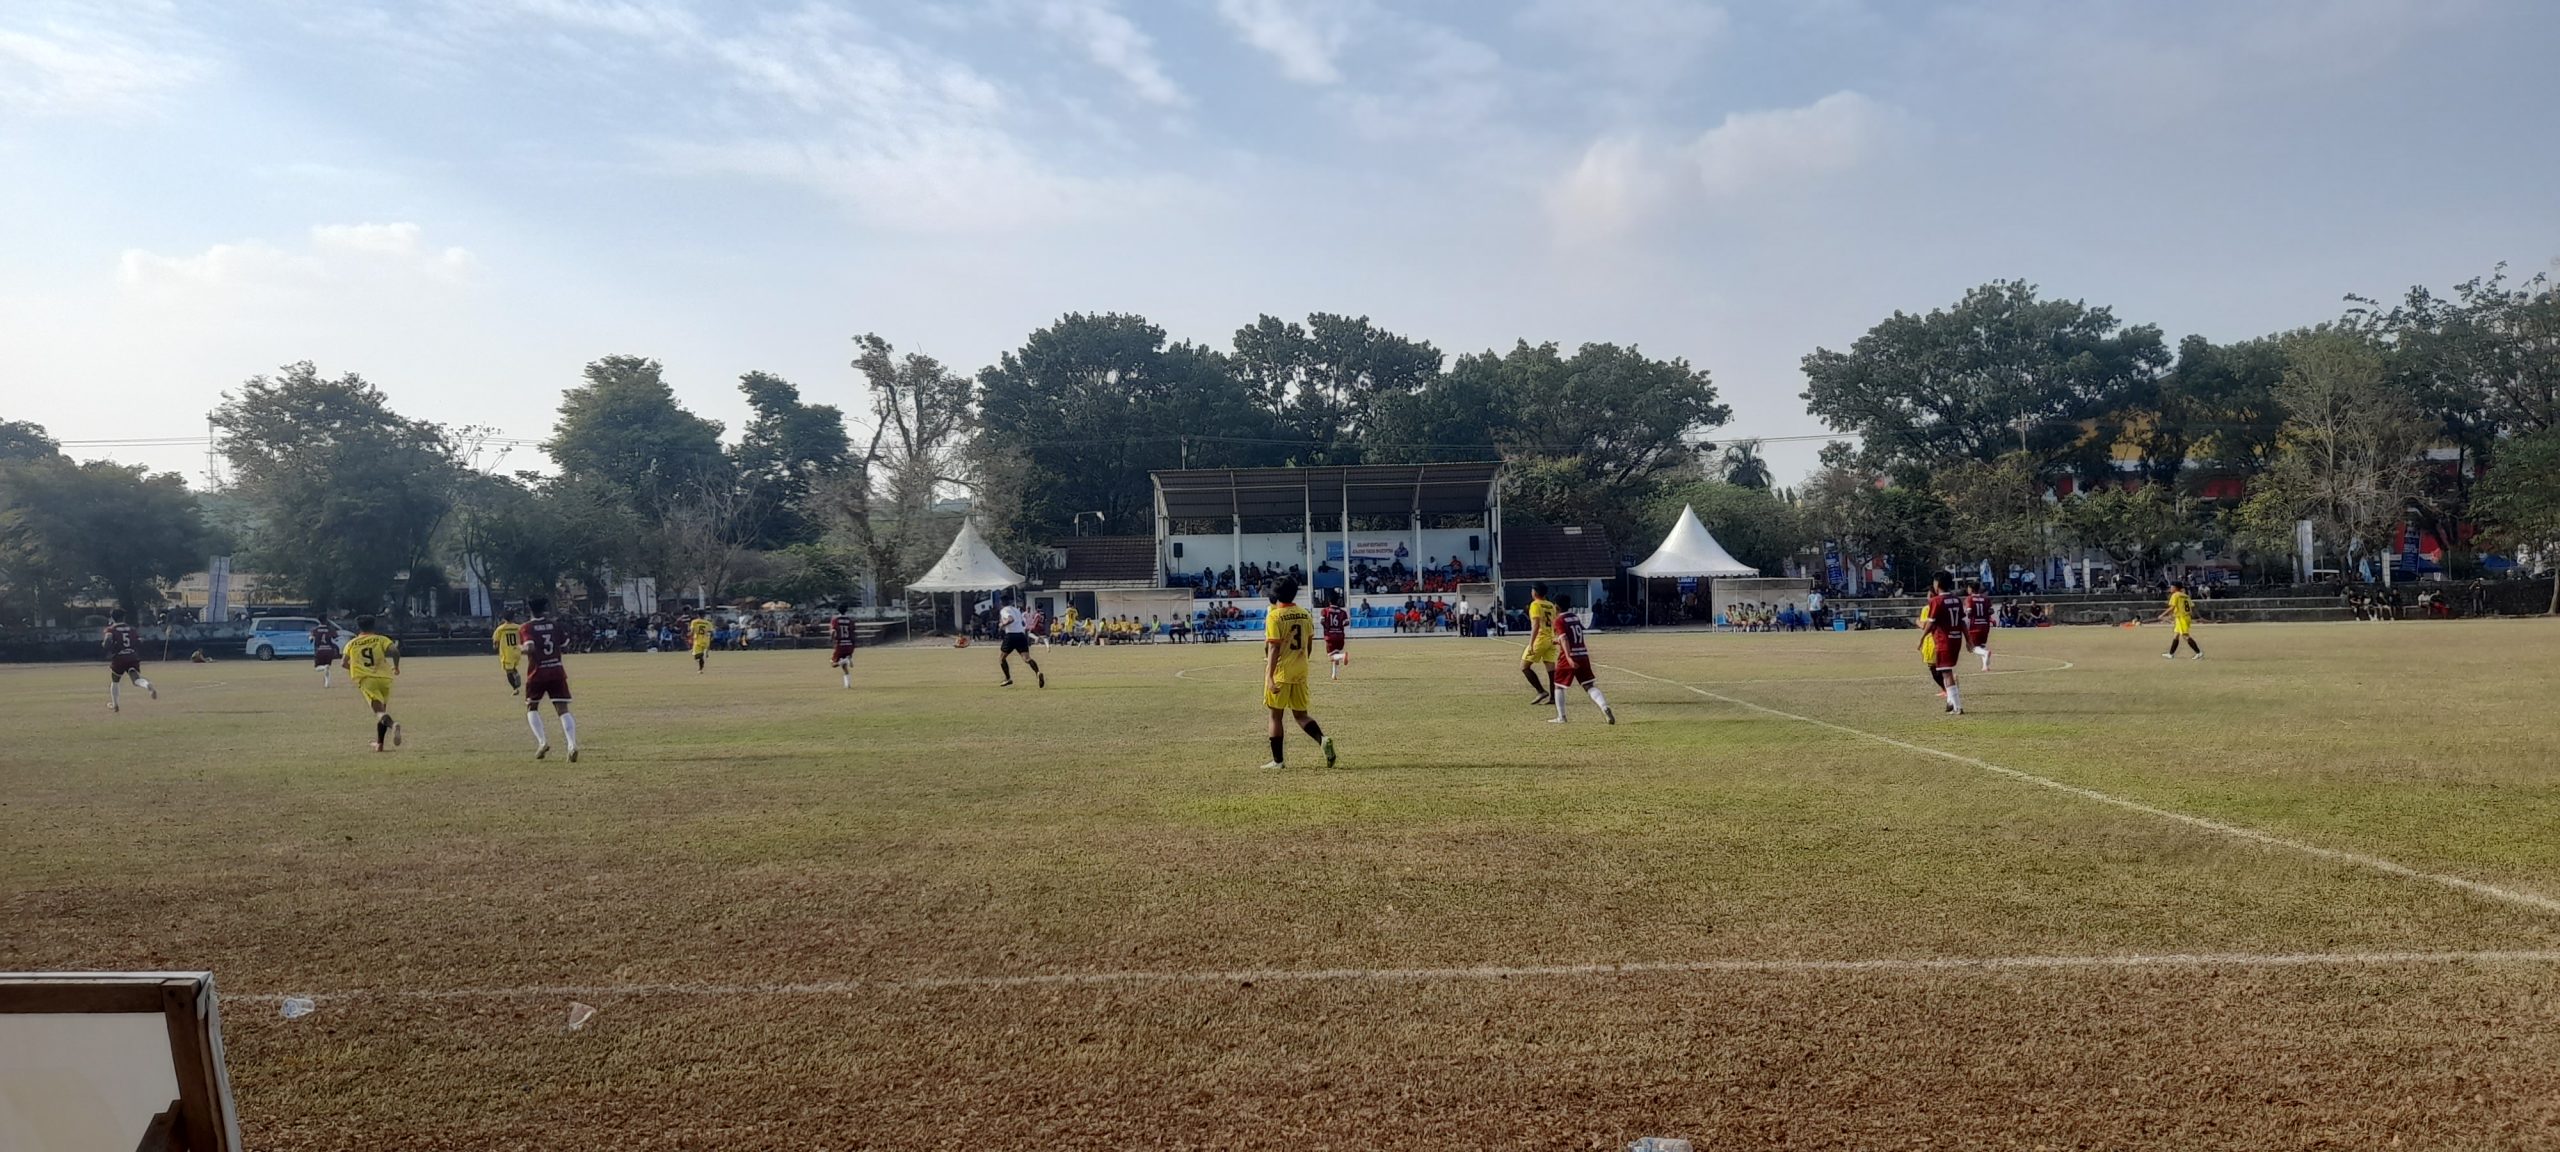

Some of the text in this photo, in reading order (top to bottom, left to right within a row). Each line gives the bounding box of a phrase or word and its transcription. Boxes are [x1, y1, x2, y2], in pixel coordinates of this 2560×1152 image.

[2184, 600, 2191, 613] 8
[1330, 614, 1339, 627] 16
[1948, 607, 1960, 627] 17
[122, 632, 130, 648] 5
[505, 633, 517, 647] 10
[840, 625, 849, 638] 13
[1290, 624, 1302, 651] 3
[1570, 624, 1583, 644] 19
[541, 633, 554, 655] 3
[361, 647, 375, 667] 9
